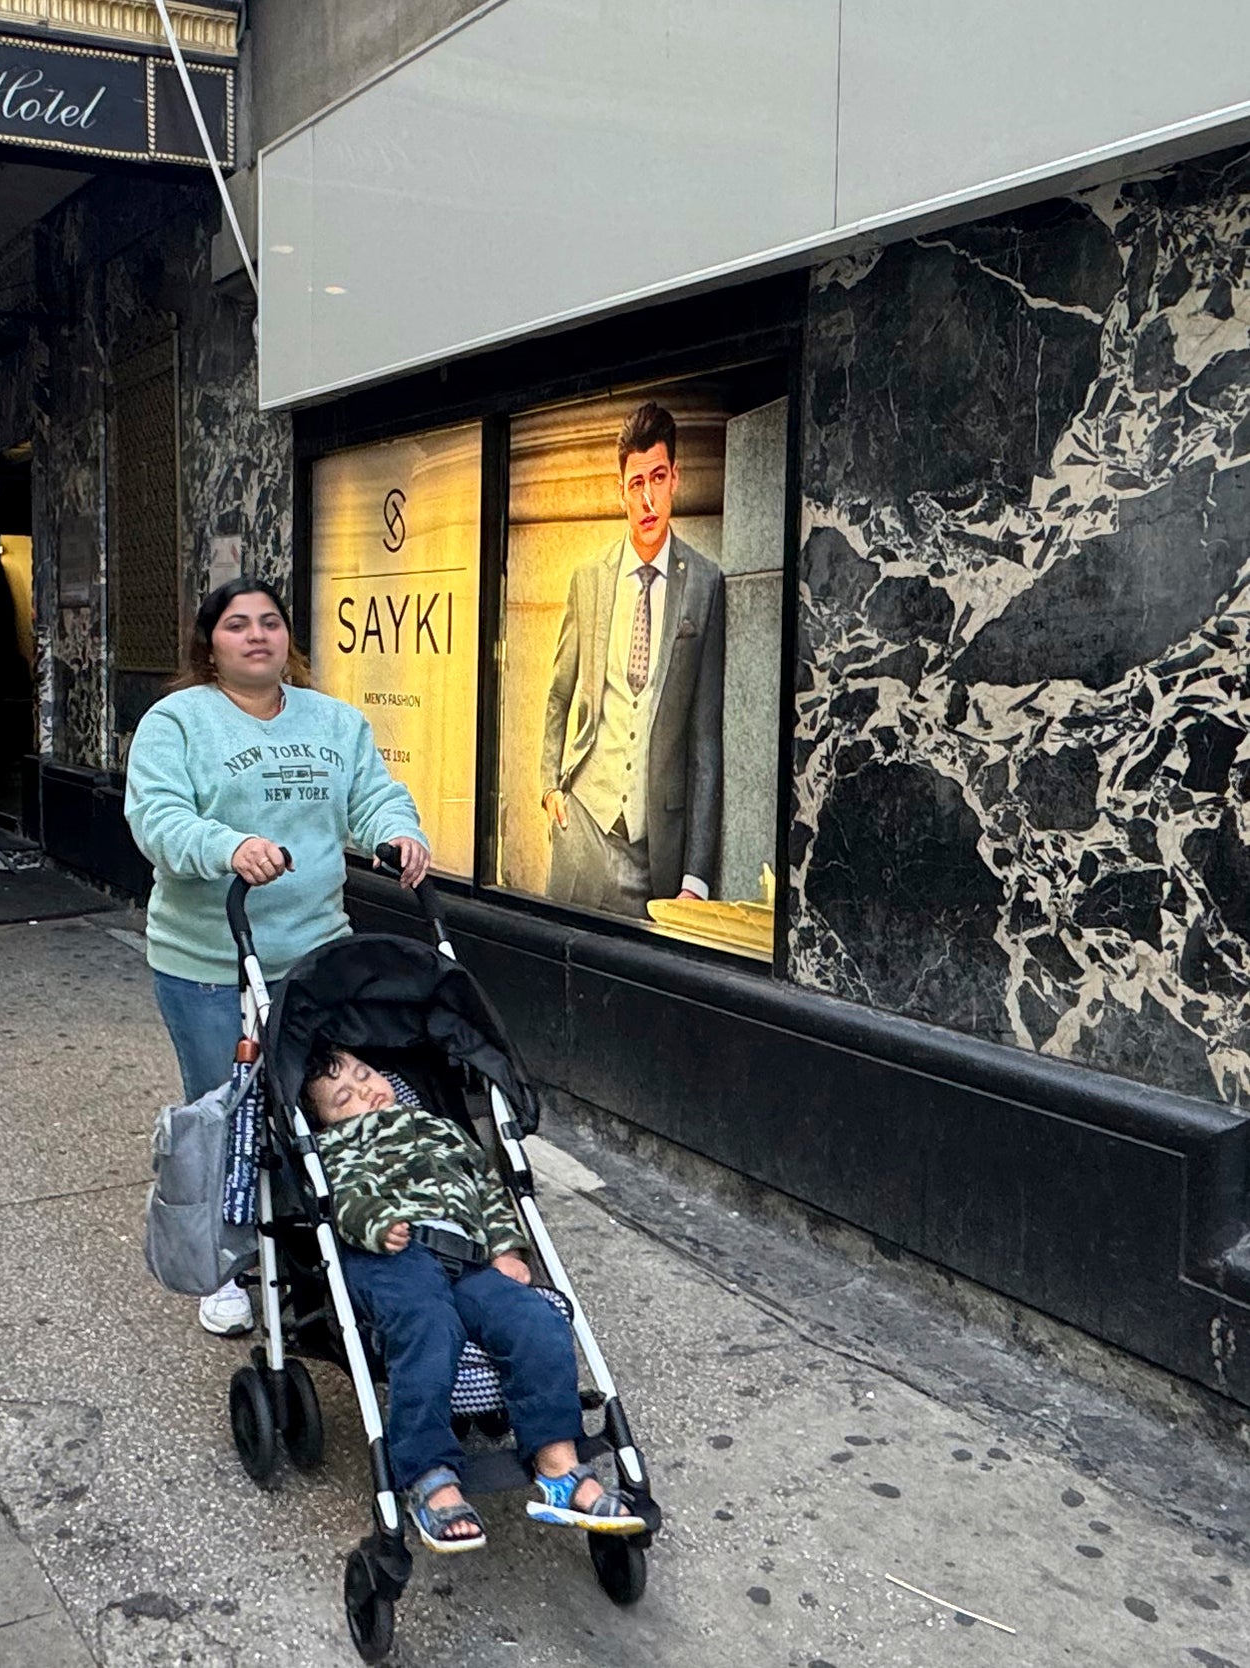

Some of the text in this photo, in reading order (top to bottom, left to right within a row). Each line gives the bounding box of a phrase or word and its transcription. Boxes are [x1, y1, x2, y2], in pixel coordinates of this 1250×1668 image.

[337, 592, 452, 654] SAYKI
[364, 692, 421, 707] MEN'S FASHION
[224, 745, 264, 777] NEW
[267, 743, 316, 759] YORK
[393, 750, 410, 763] 1924
[264, 786, 330, 802] NEW YORK
